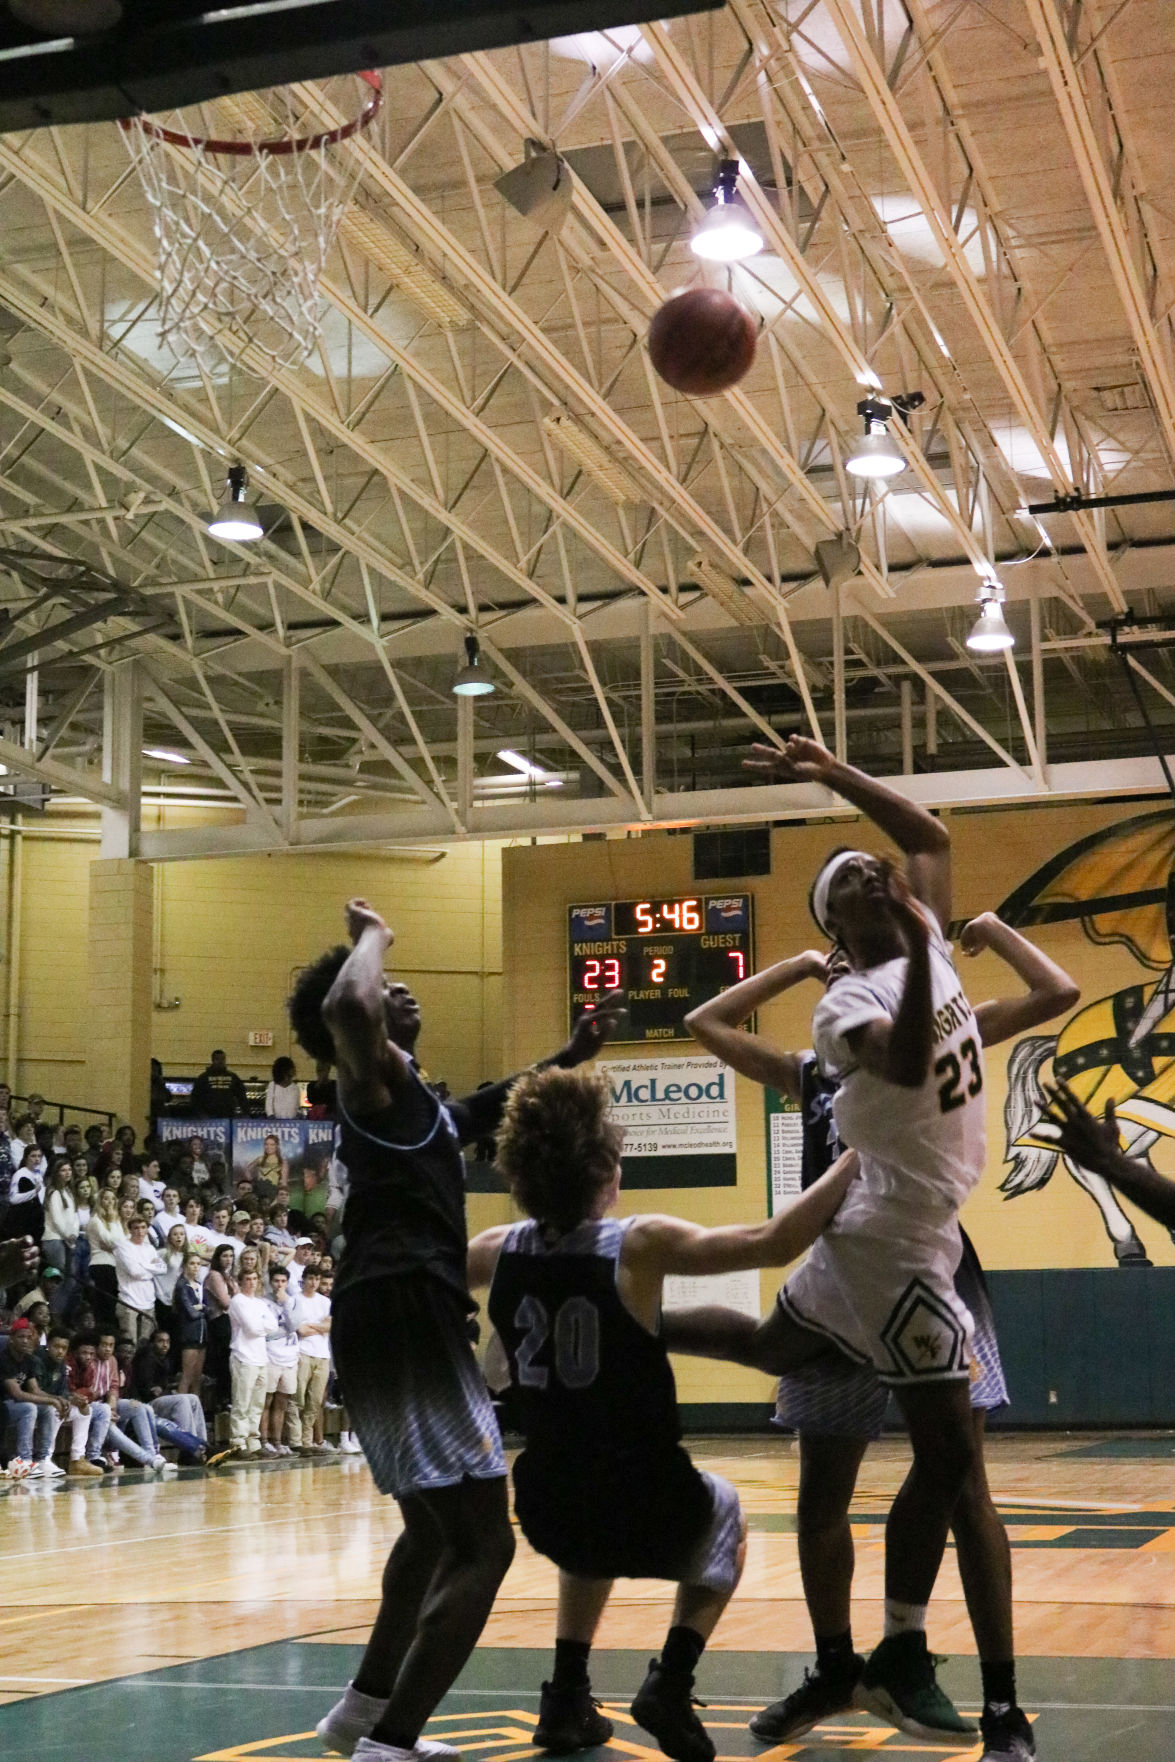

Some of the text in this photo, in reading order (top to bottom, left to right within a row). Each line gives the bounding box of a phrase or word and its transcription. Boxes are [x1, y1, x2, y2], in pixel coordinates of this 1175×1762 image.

[708, 899, 743, 910] PEPSI
[572, 907, 606, 918] PEPSI
[636, 900, 699, 933] 5:46
[701, 934, 742, 948] GUEST
[574, 941, 627, 956] KNIGHTS
[643, 946, 674, 955] PERIOD
[651, 959, 666, 983] 2
[728, 951, 744, 979] 7
[584, 959, 620, 989] 23
[573, 992, 600, 1003] FOULS
[628, 988, 690, 1000] PLAYER FOUL
[254, 1032, 269, 1044] EXIT
[645, 1028, 675, 1039] MATCH
[632, 1063, 658, 1072] Athletic
[661, 1062, 685, 1070] Trainer
[686, 1061, 717, 1069] Provided
[935, 1036, 983, 1114] 23
[610, 1073, 727, 1104] McLeod
[658, 1107, 729, 1120] Medicine
[162, 1126, 225, 1143] KNIGHTS
[238, 1127, 300, 1143] KNIGHTS
[658, 1126, 688, 1136] Medical
[661, 1141, 733, 1149] www.mcleodhealth.org
[514, 1295, 600, 1389] 20
